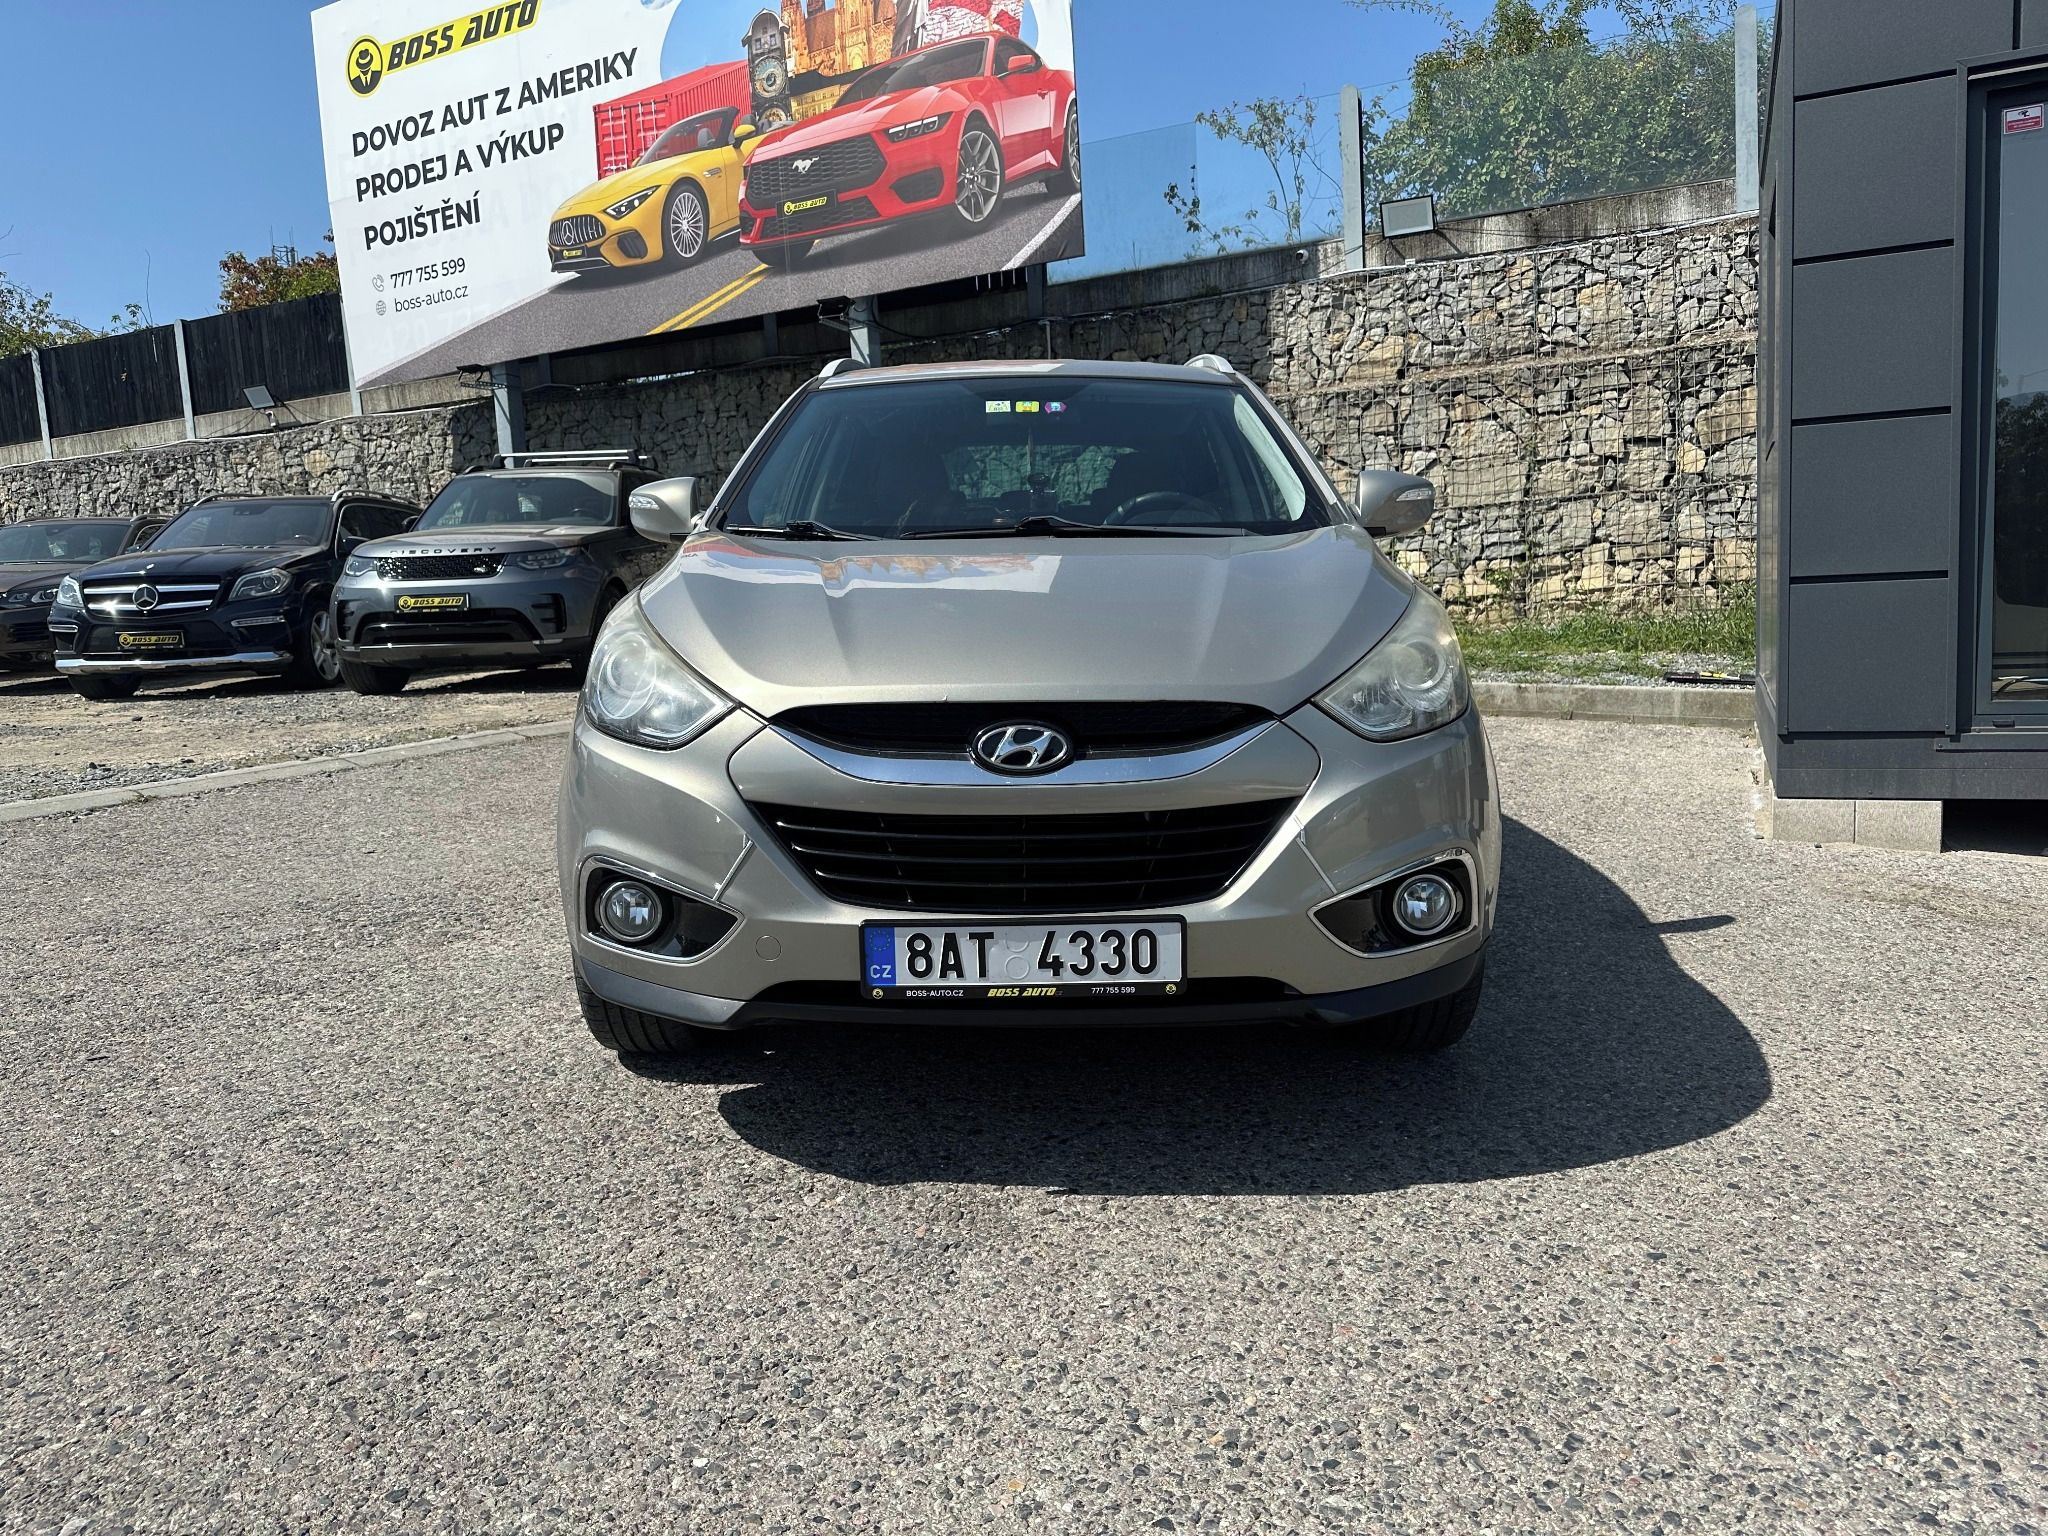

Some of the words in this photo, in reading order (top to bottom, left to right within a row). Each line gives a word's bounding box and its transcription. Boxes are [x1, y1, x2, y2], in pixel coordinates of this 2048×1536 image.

[387, 24, 455, 72] BOSS
[461, 0, 538, 48] AUTO
[352, 110, 435, 158] DOVOZ
[441, 93, 489, 132] AUT
[495, 87, 512, 116] Z
[518, 48, 638, 110] AMERIKY
[356, 154, 447, 203] PRODEJ
[454, 149, 473, 177] A
[476, 123, 564, 168] VÝKUP
[364, 190, 481, 250] POJIŠTĚNÍ
[390, 269, 413, 288] 777
[416, 264, 439, 283] 755
[441, 257, 466, 277] 599
[394, 286, 469, 312] boss-auto.cz
[413, 598, 435, 606] BOSS
[437, 597, 462, 605] AUTO
[905, 931, 995, 979] 8AT
[1036, 928, 1158, 978] 4330
[870, 965, 892, 979] CZ
[906, 989, 964, 997] BOSS-AUTO.CZ
[987, 988, 1020, 997] BOSS
[1021, 987, 1057, 996] AUTO
[1120, 986, 1136, 994] 599
